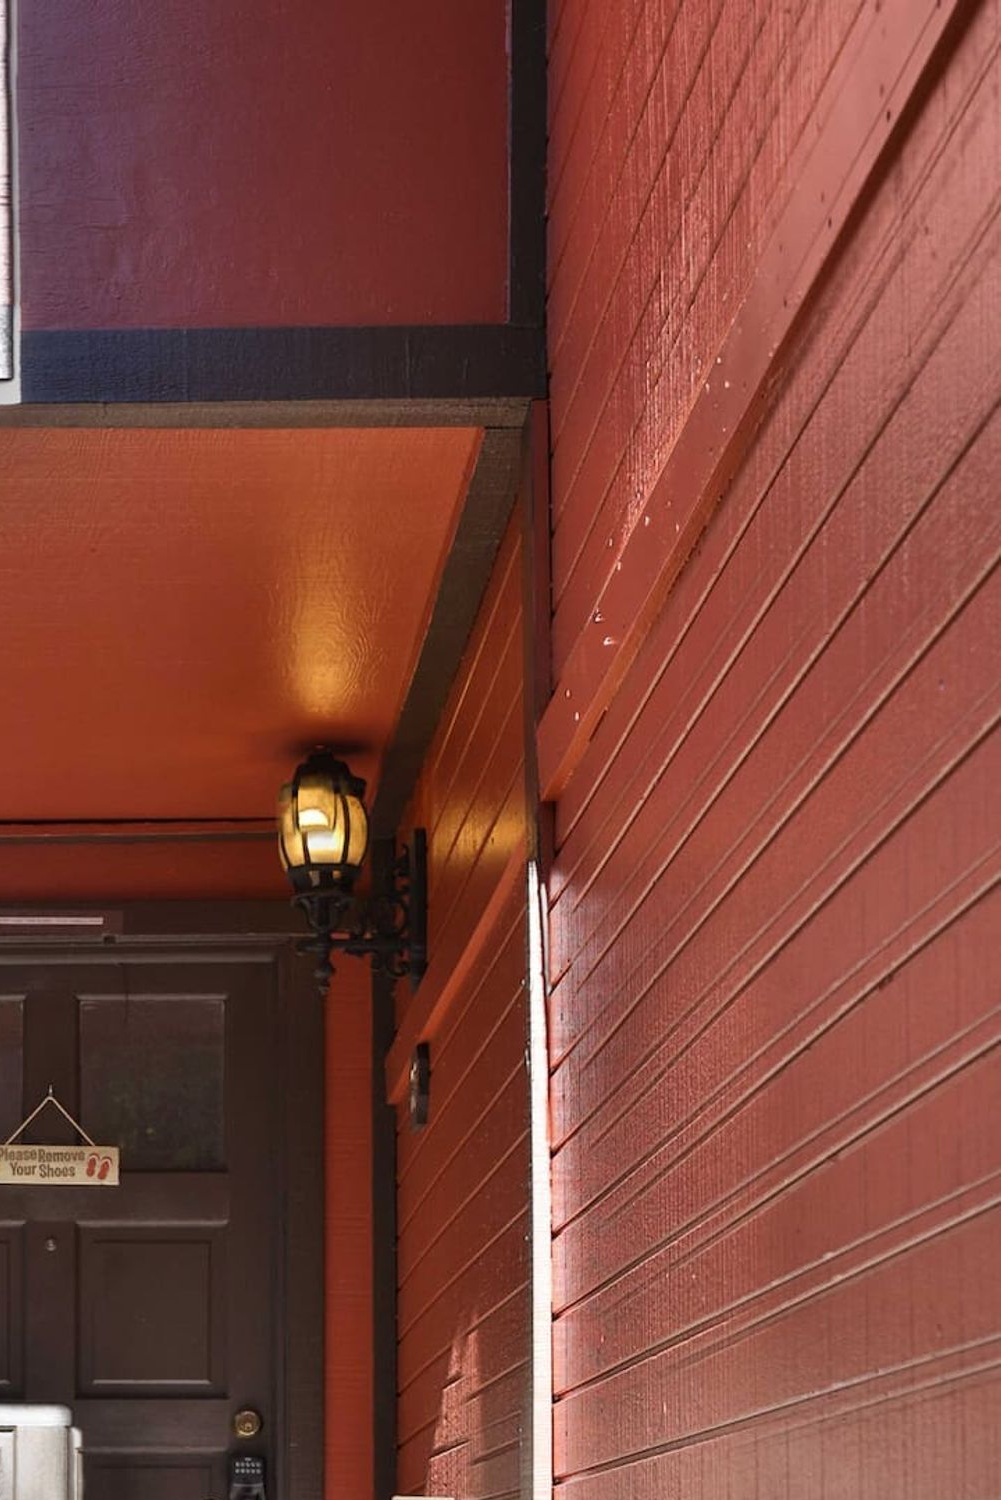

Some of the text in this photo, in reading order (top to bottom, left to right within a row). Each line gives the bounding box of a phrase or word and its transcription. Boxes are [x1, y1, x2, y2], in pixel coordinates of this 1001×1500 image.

[38, 1149, 86, 1163] Remove
[10, 1162, 76, 1179] Your Shoes
